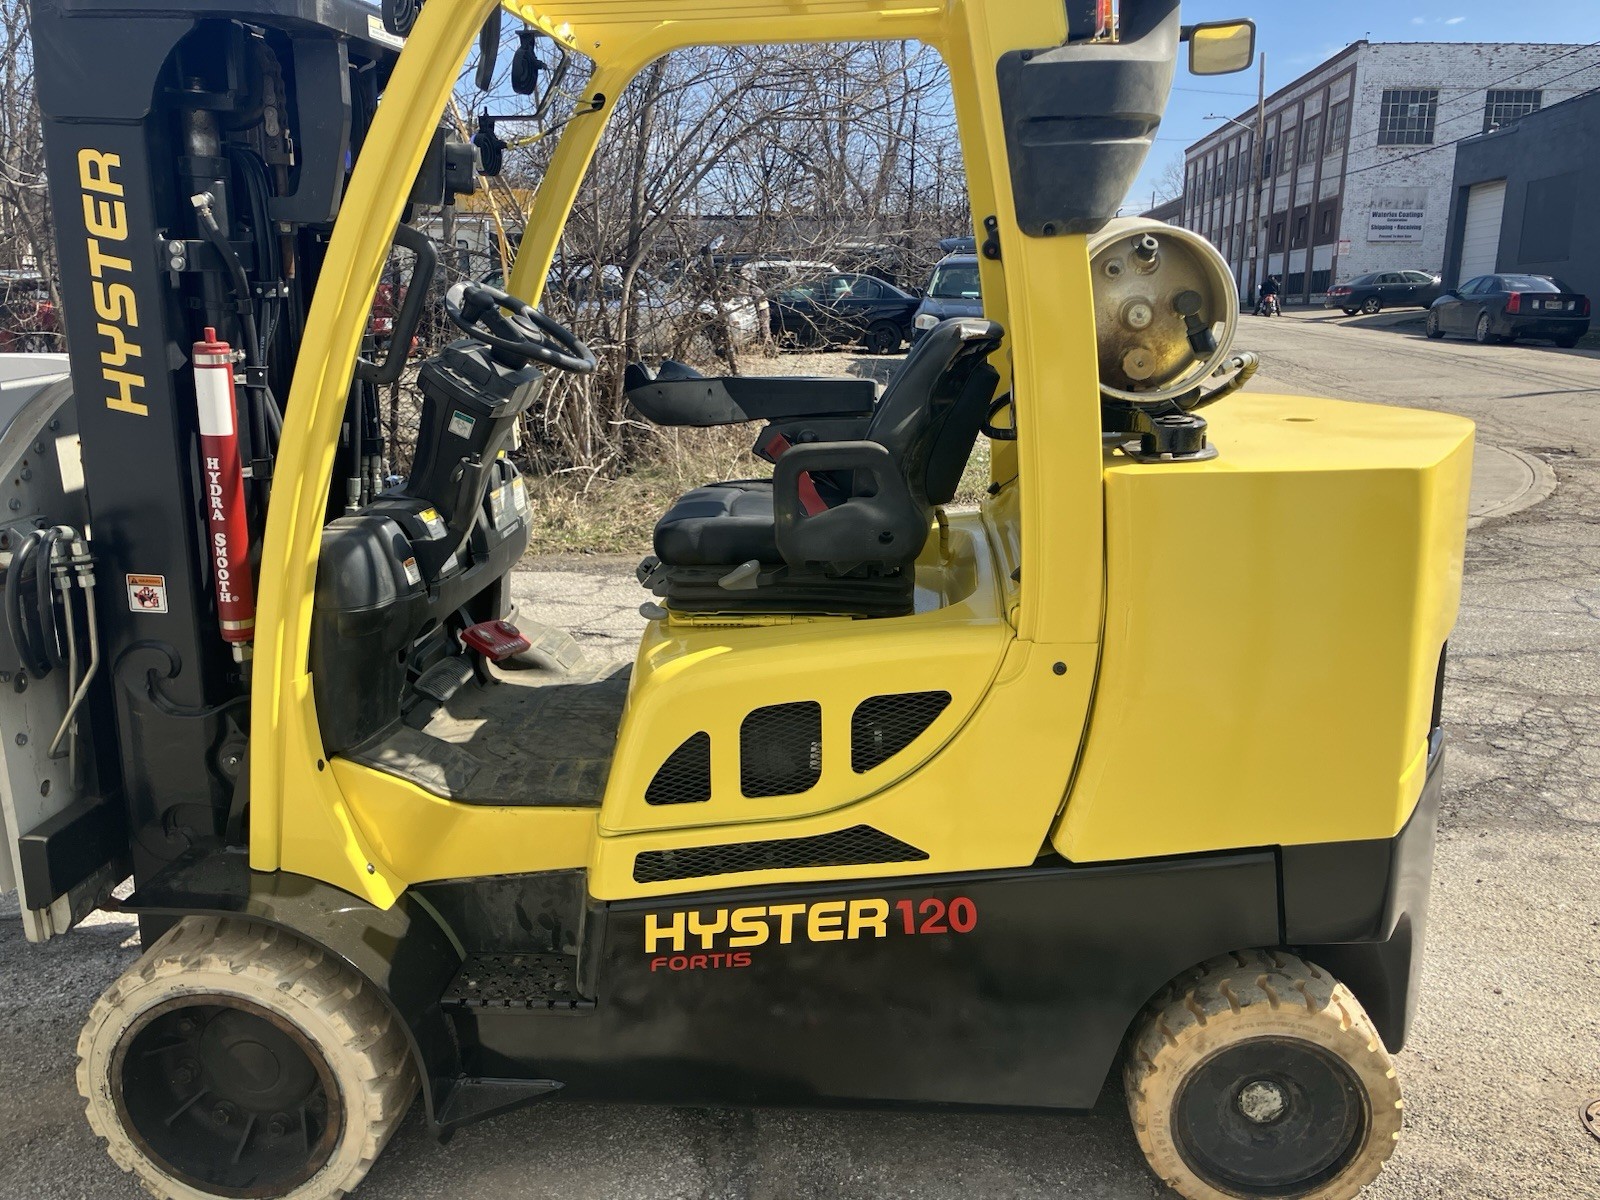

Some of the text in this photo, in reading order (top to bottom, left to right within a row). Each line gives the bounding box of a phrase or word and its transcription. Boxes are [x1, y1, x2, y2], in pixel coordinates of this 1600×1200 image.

[78, 148, 148, 416] HYSTER
[206, 457, 225, 521] HYDRA
[644, 896, 978, 953] HYSTER 120
[650, 951, 752, 972] FORTIS
